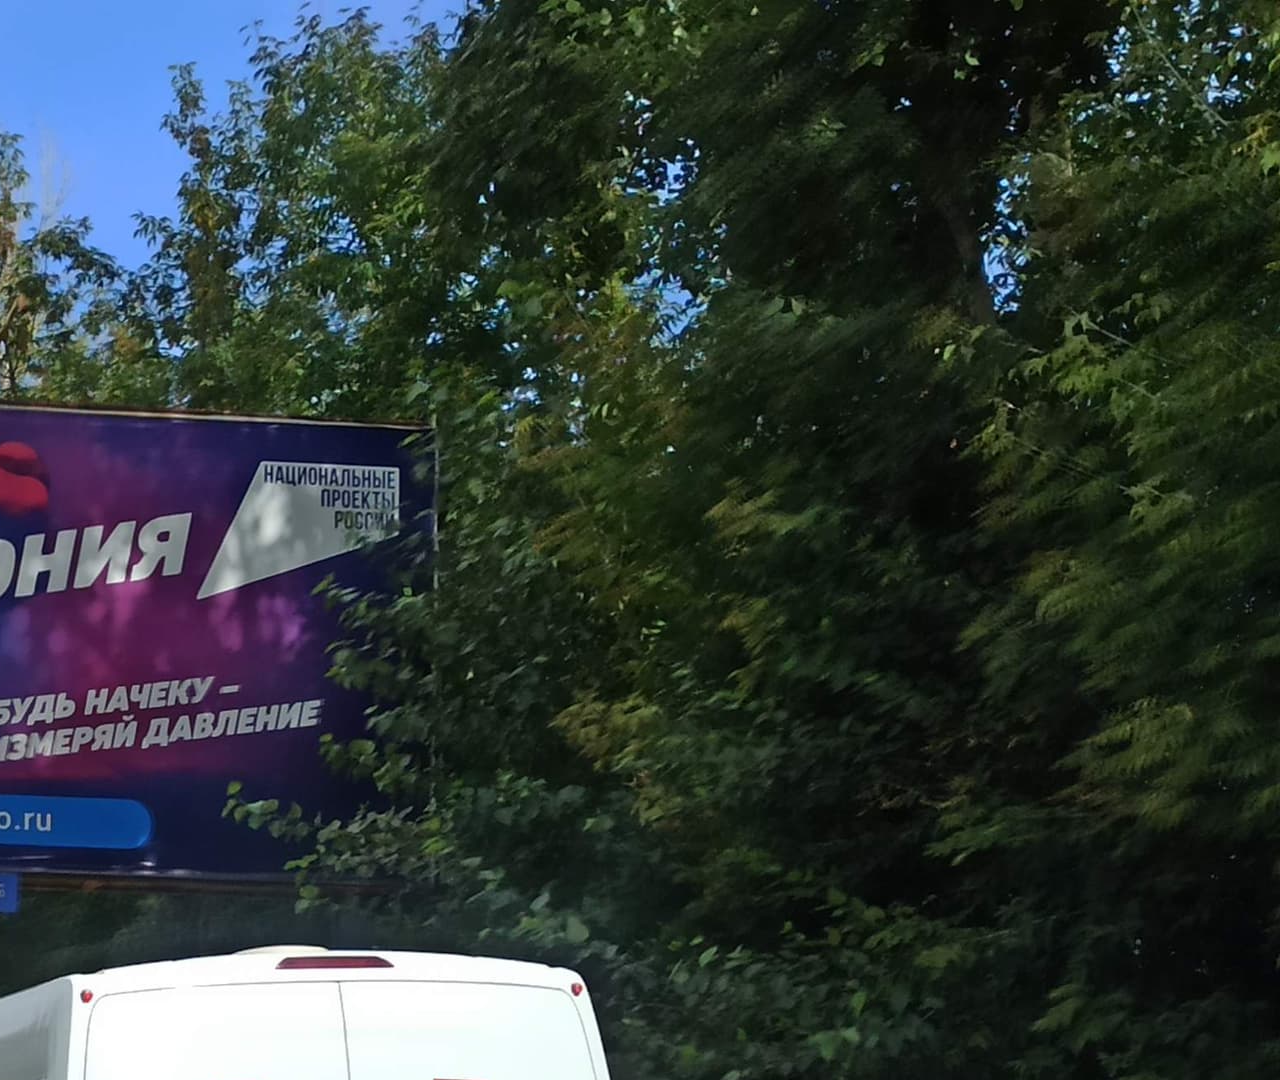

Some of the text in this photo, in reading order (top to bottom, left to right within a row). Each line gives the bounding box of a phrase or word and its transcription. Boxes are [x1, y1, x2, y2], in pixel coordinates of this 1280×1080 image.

[263, 464, 396, 489] НАЦИОНАЛЬНЫЕ
[321, 489, 395, 509] ПРОЕКТЫ
[84, 675, 216, 715] НАЧЕКУ
[142, 699, 325, 749] ДАВЛЕНИЕ
